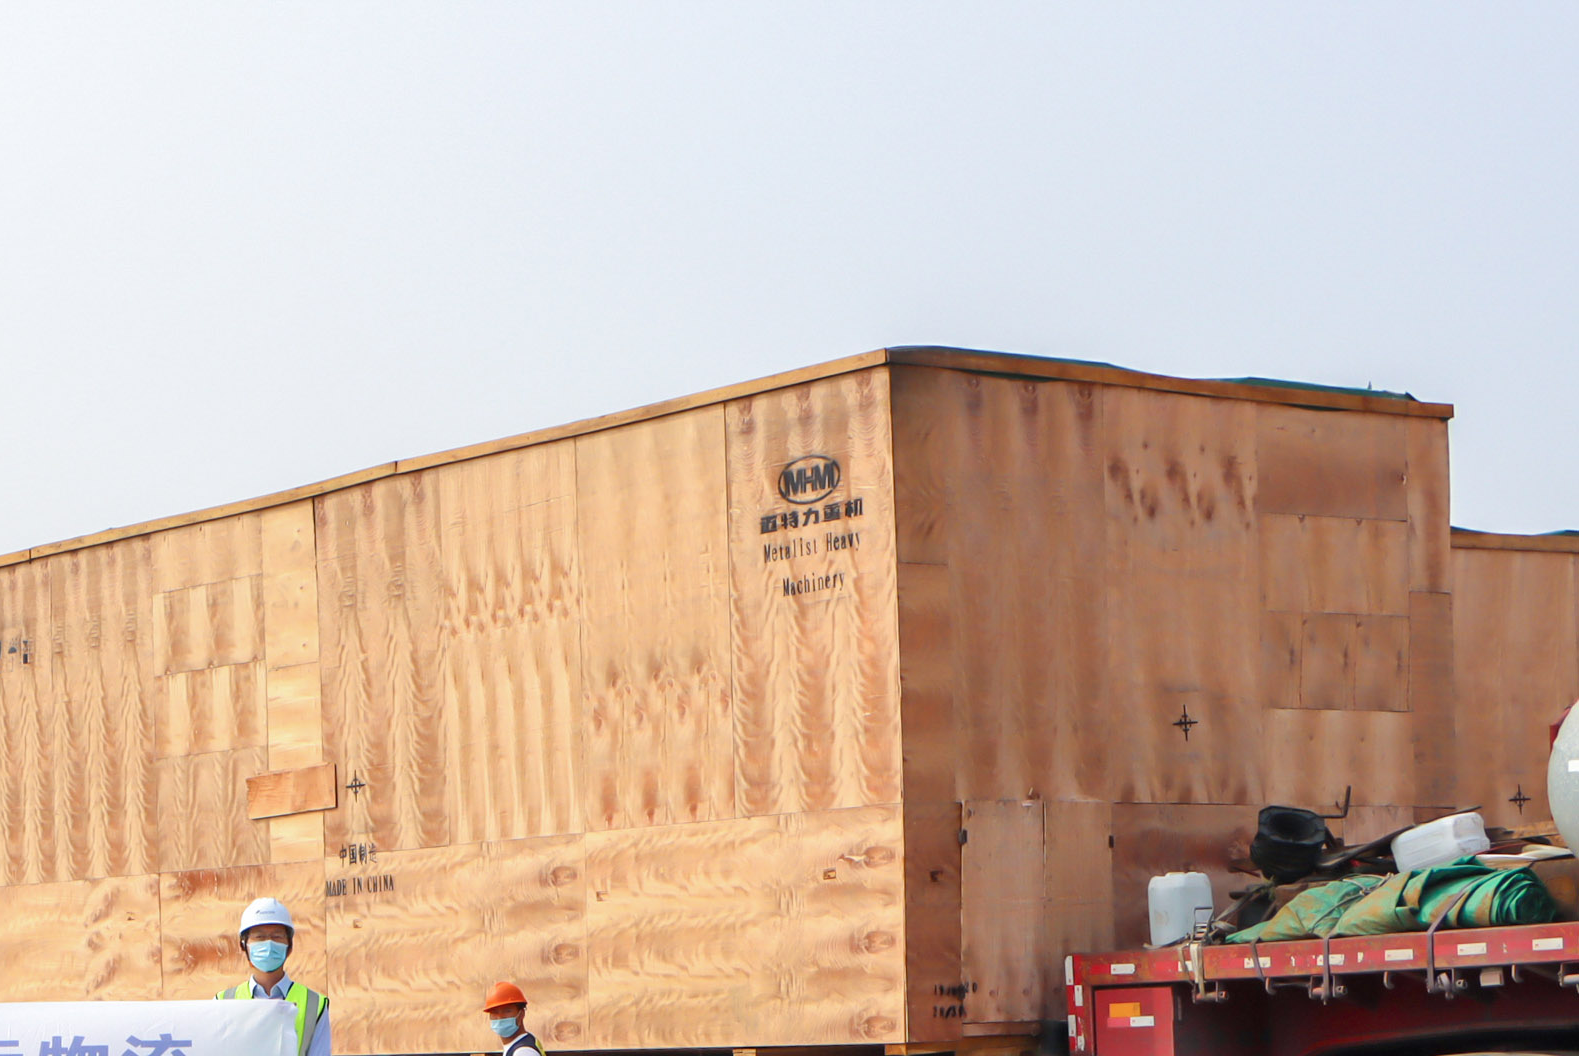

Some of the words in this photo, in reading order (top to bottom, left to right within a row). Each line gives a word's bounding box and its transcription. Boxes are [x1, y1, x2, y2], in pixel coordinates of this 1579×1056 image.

[763, 537, 818, 563] Metalist
[826, 531, 861, 552] Heavy
[782, 572, 845, 597] Machinery
[339, 843, 378, 868] 中国制造
[325, 879, 347, 897] MADE
[353, 876, 363, 895] IN
[367, 874, 395, 893] CHINA
